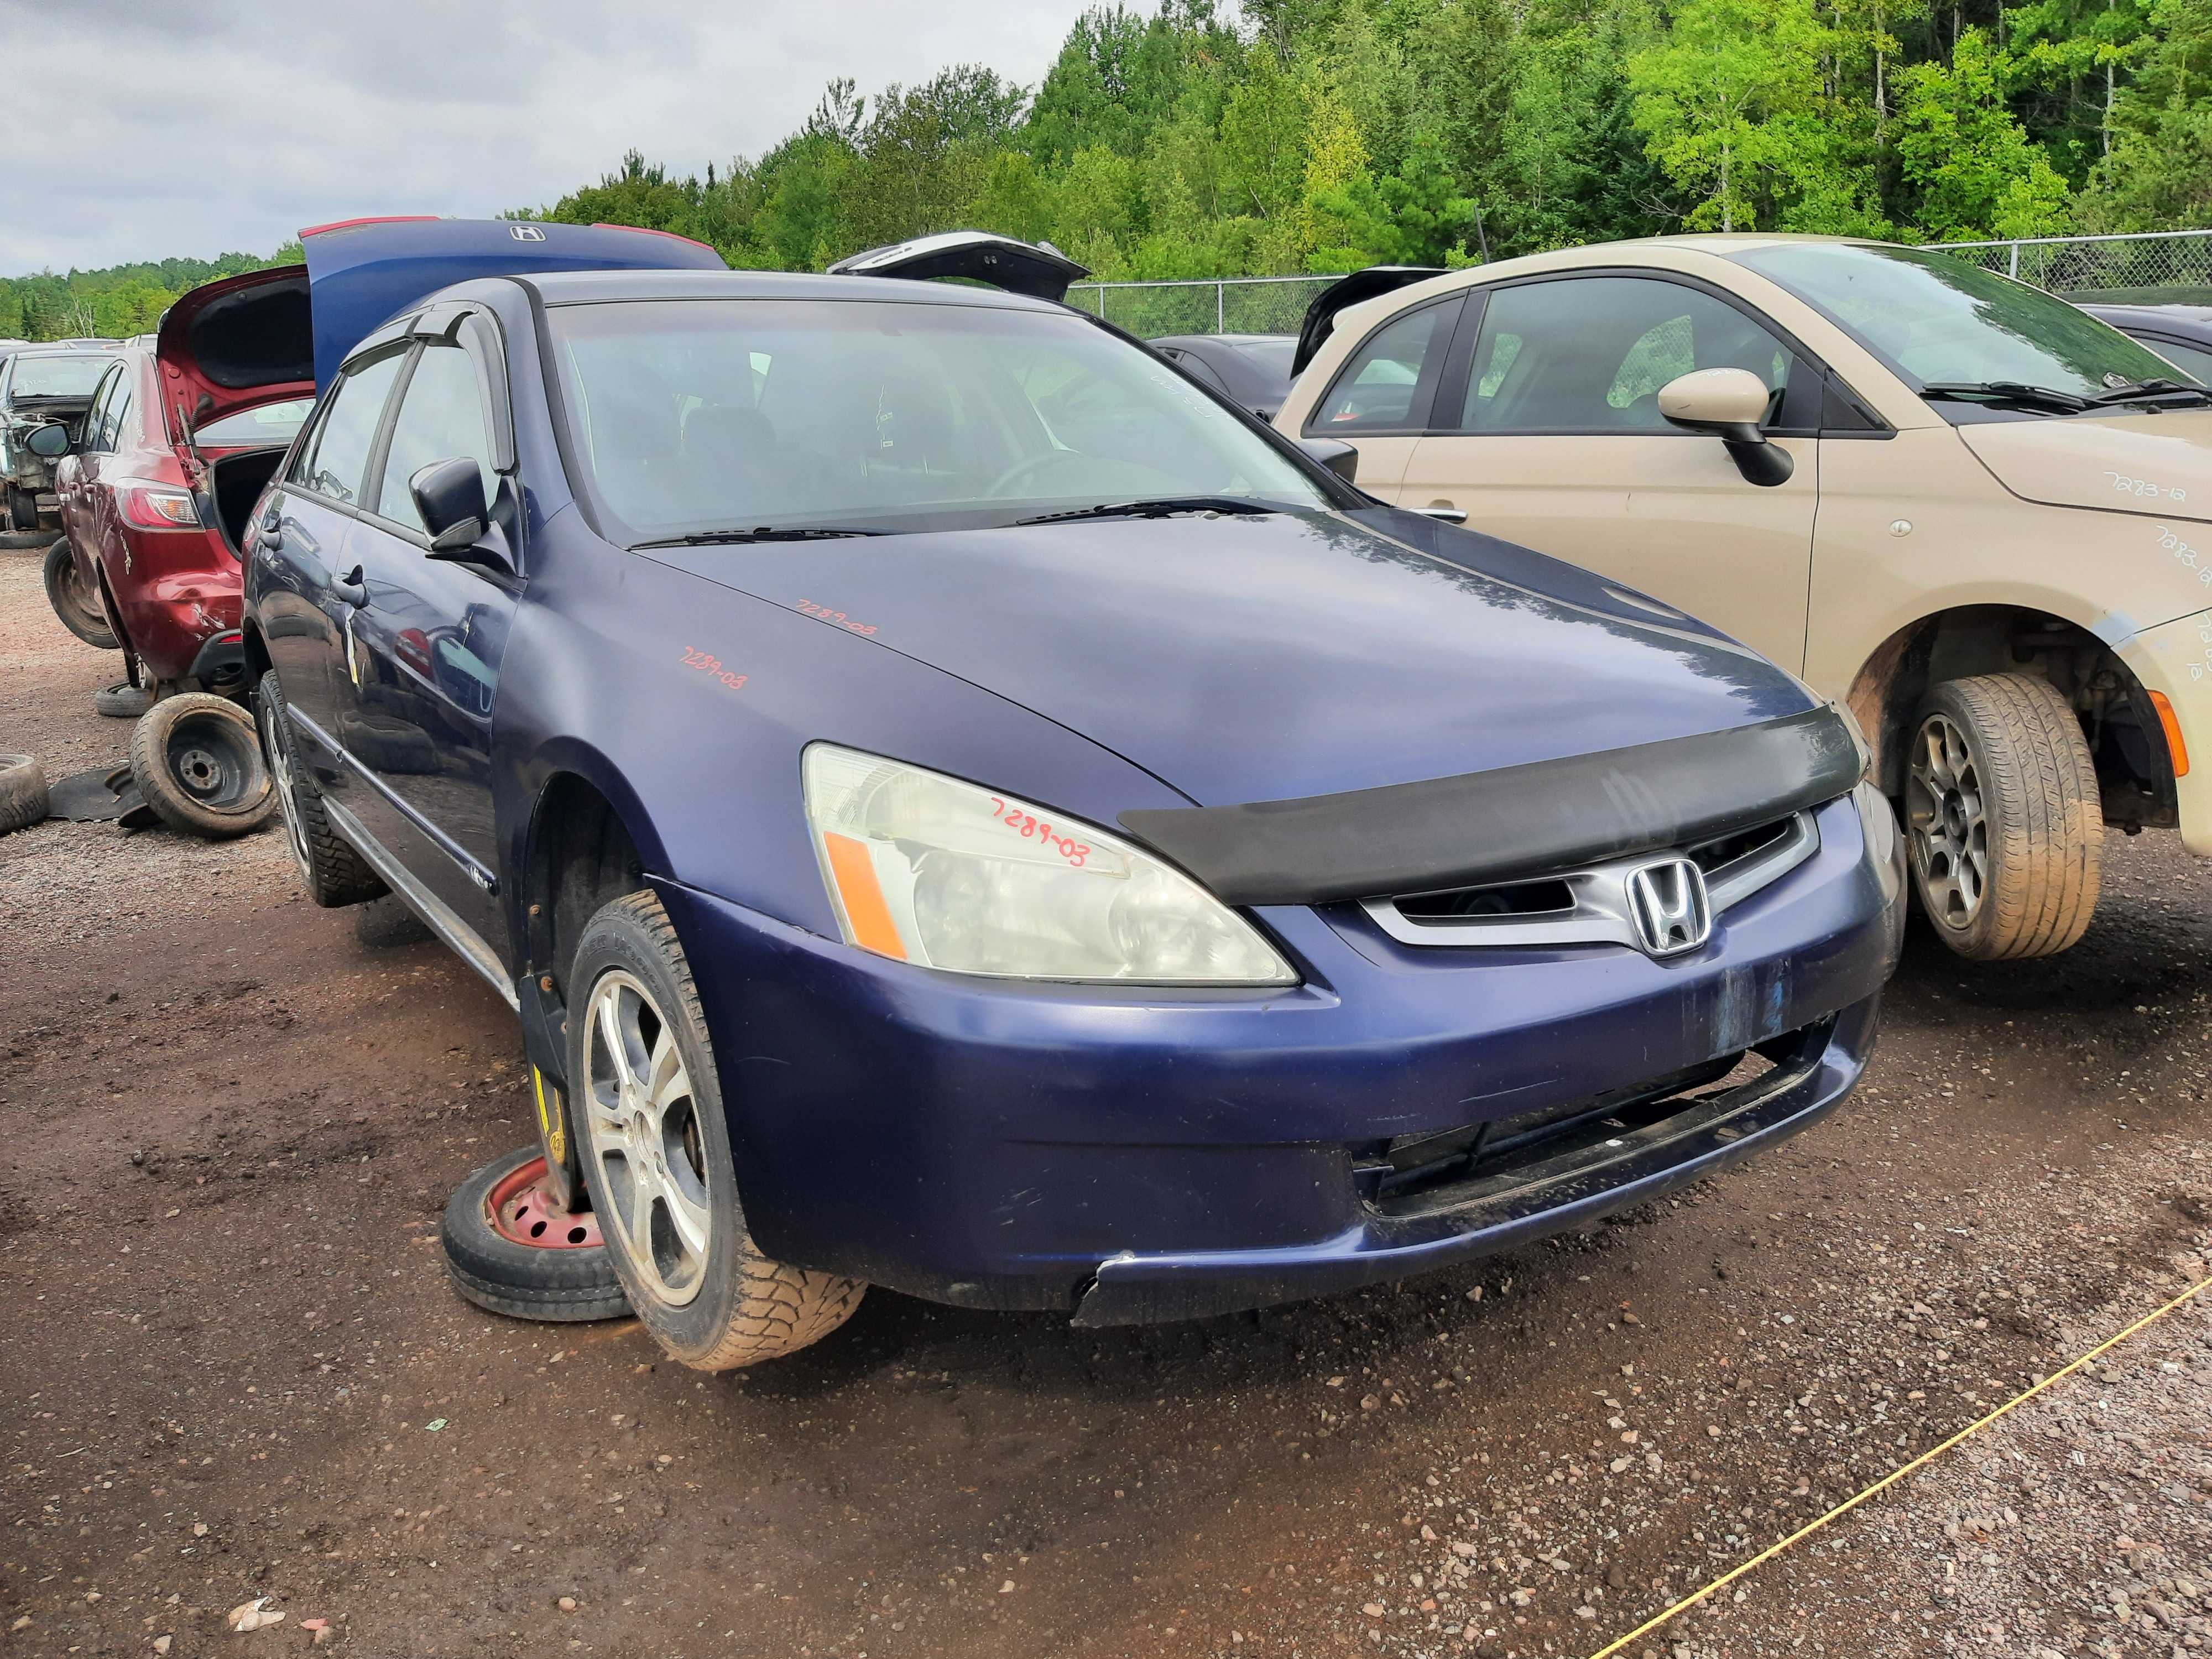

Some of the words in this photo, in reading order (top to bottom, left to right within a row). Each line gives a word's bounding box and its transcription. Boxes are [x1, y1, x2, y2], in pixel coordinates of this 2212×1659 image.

[2103, 471, 2185, 501] 7283-12
[2156, 525, 2212, 588] 7283-12
[796, 599, 878, 635] 7289-03
[991, 796, 1091, 867] 7289-03
[1637, 860, 1699, 951] H
